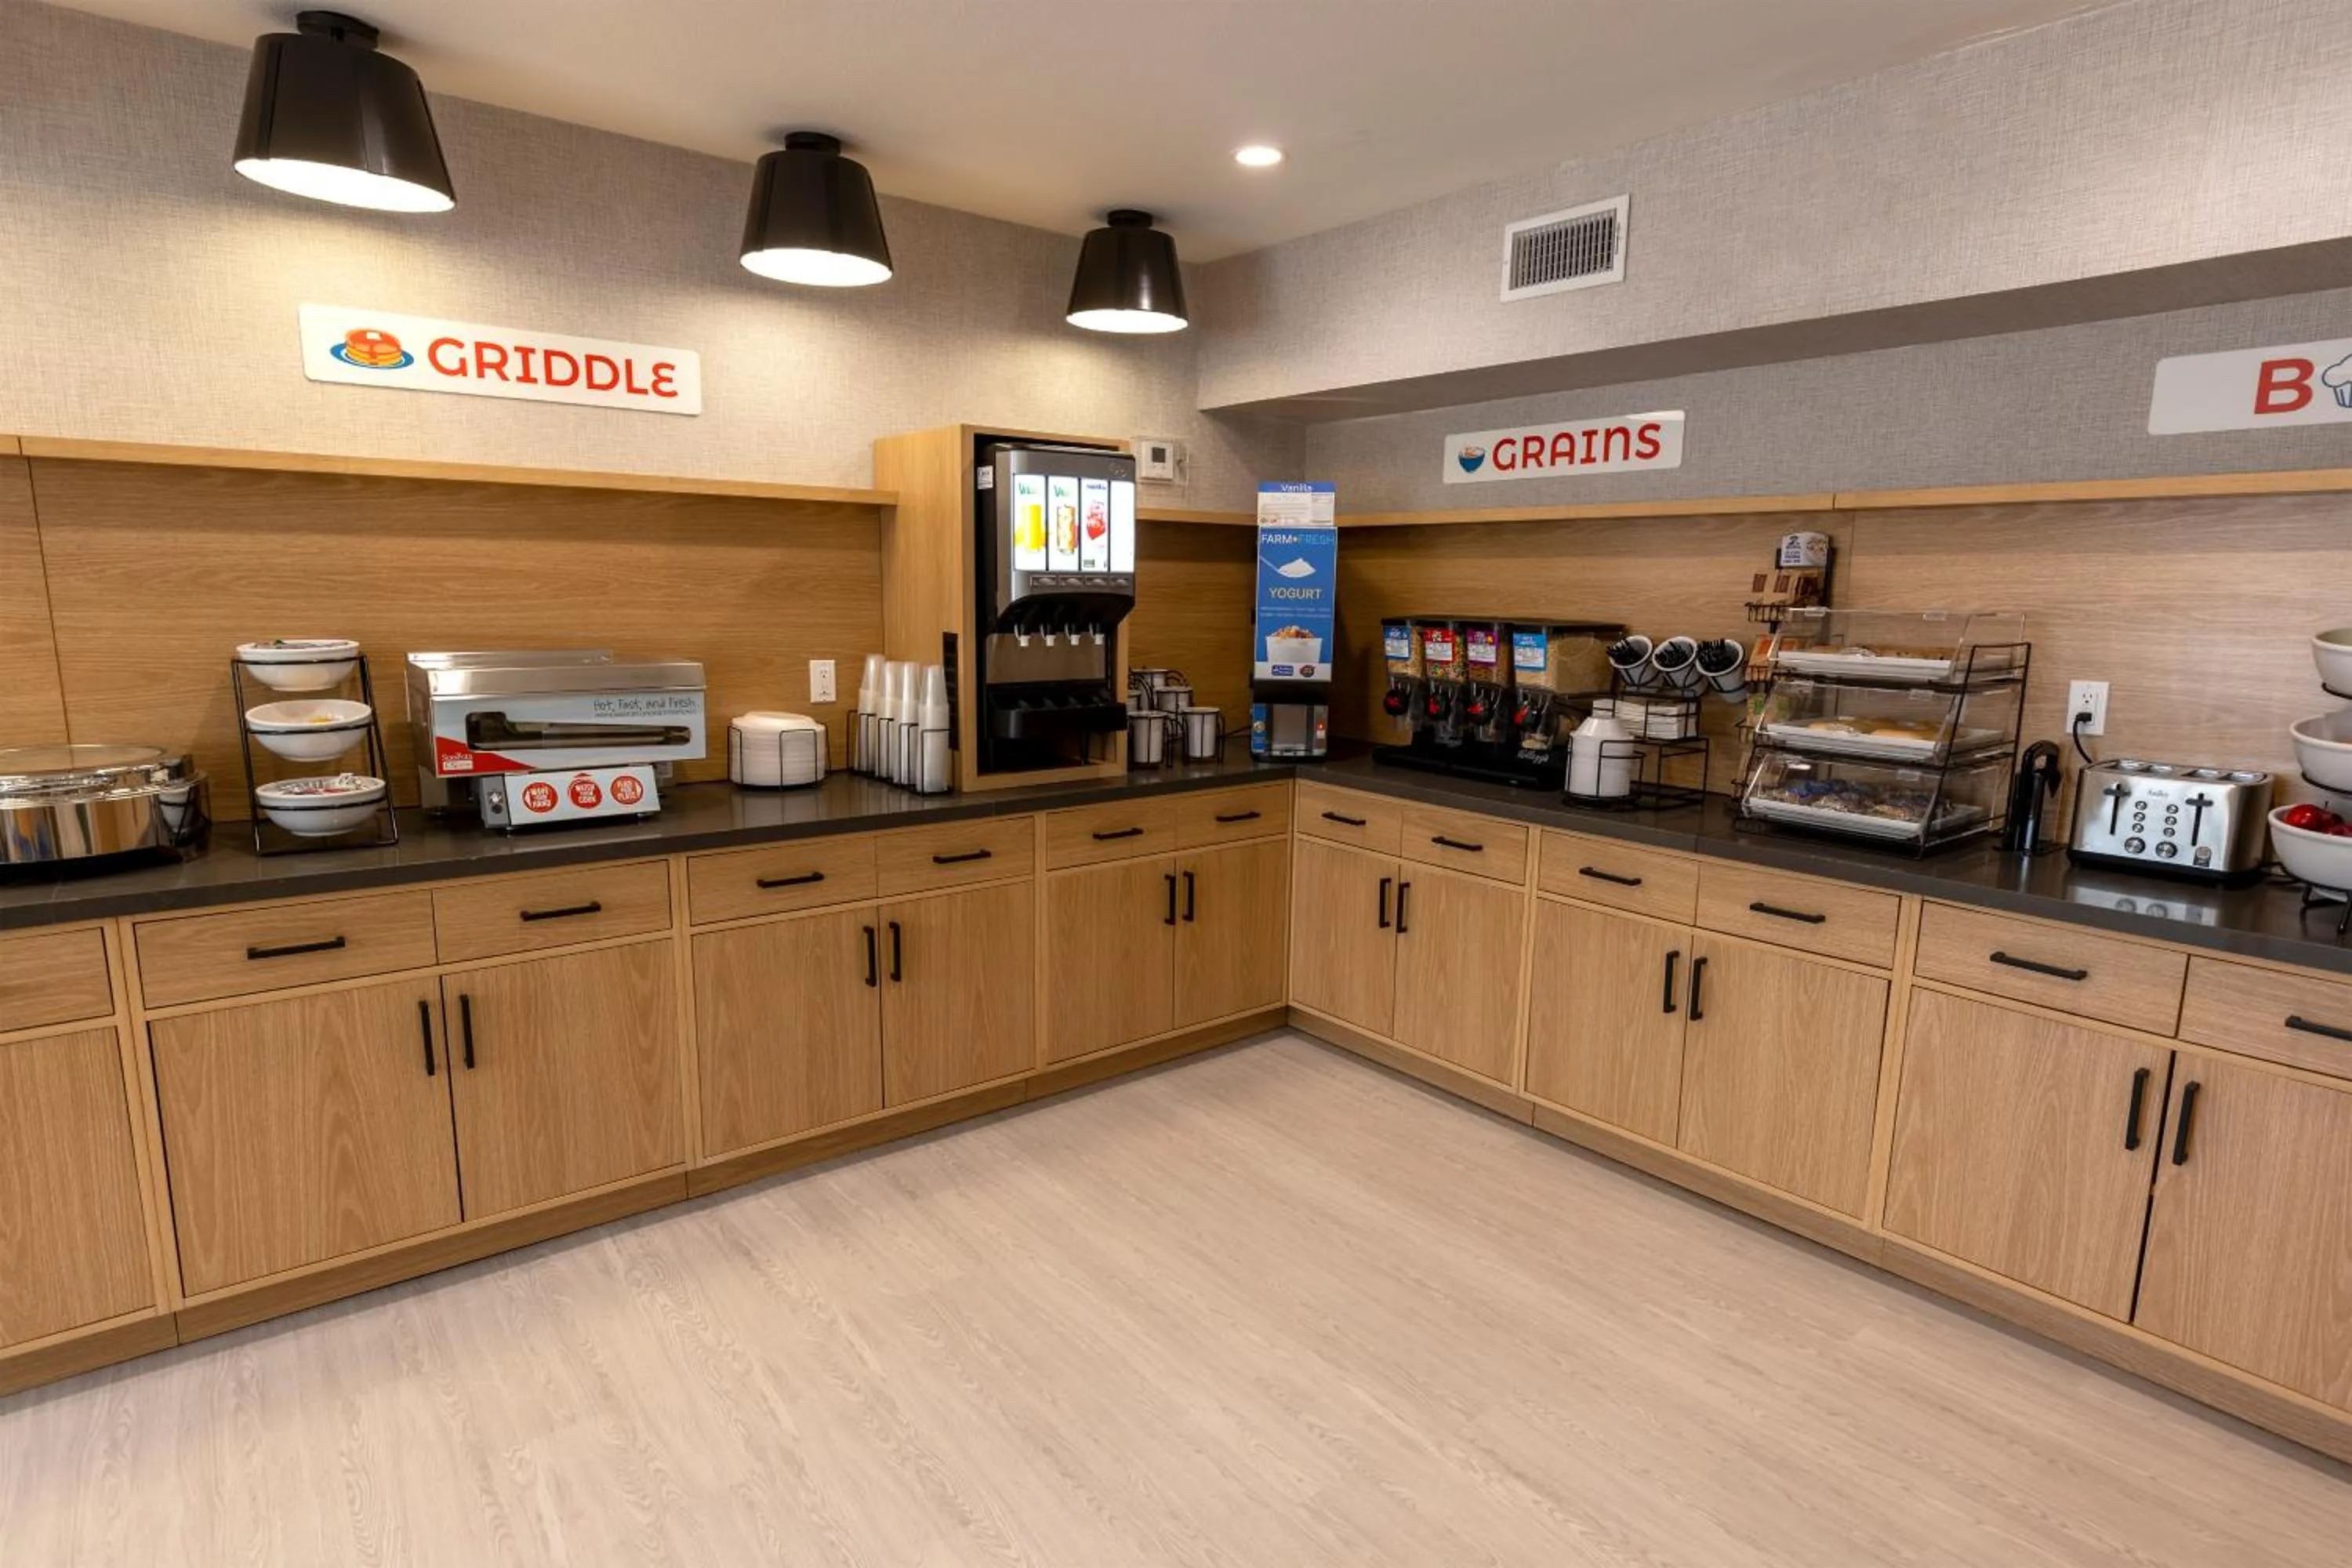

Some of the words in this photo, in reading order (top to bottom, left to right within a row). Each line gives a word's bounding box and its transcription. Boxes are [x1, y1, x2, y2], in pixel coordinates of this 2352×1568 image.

[427, 336, 679, 398] GRIDDLE
[2254, 358, 2315, 415] B
[1491, 423, 1661, 471] GRAINS
[1280, 482, 1313, 492] Vanilla
[1261, 534, 1293, 545] FARM
[1269, 587, 1323, 600] YOGURT
